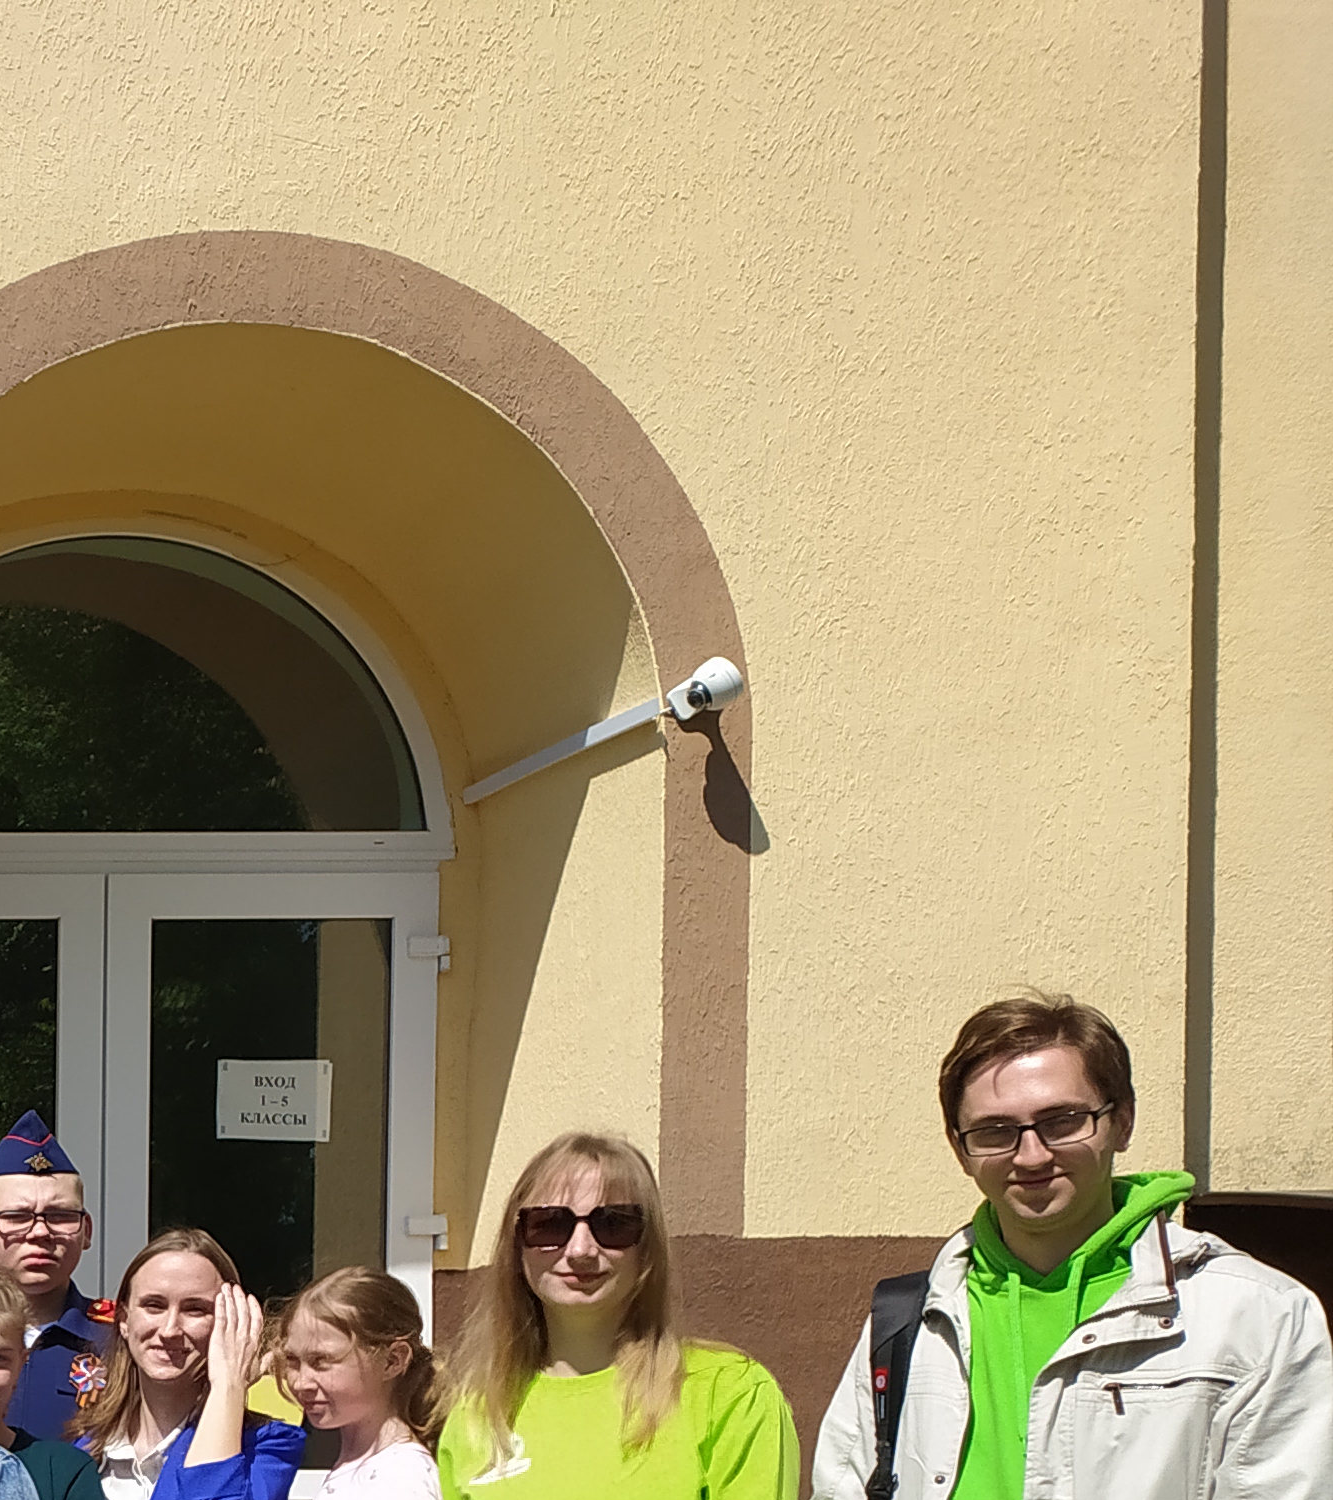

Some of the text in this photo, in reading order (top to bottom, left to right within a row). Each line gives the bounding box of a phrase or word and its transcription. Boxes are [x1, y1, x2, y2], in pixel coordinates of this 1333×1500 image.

[254, 1076, 296, 1089] ВХОД
[261, 1095, 266, 1106] 1
[281, 1096, 289, 1107] 5
[240, 1112, 307, 1126] КЛАССЫ
